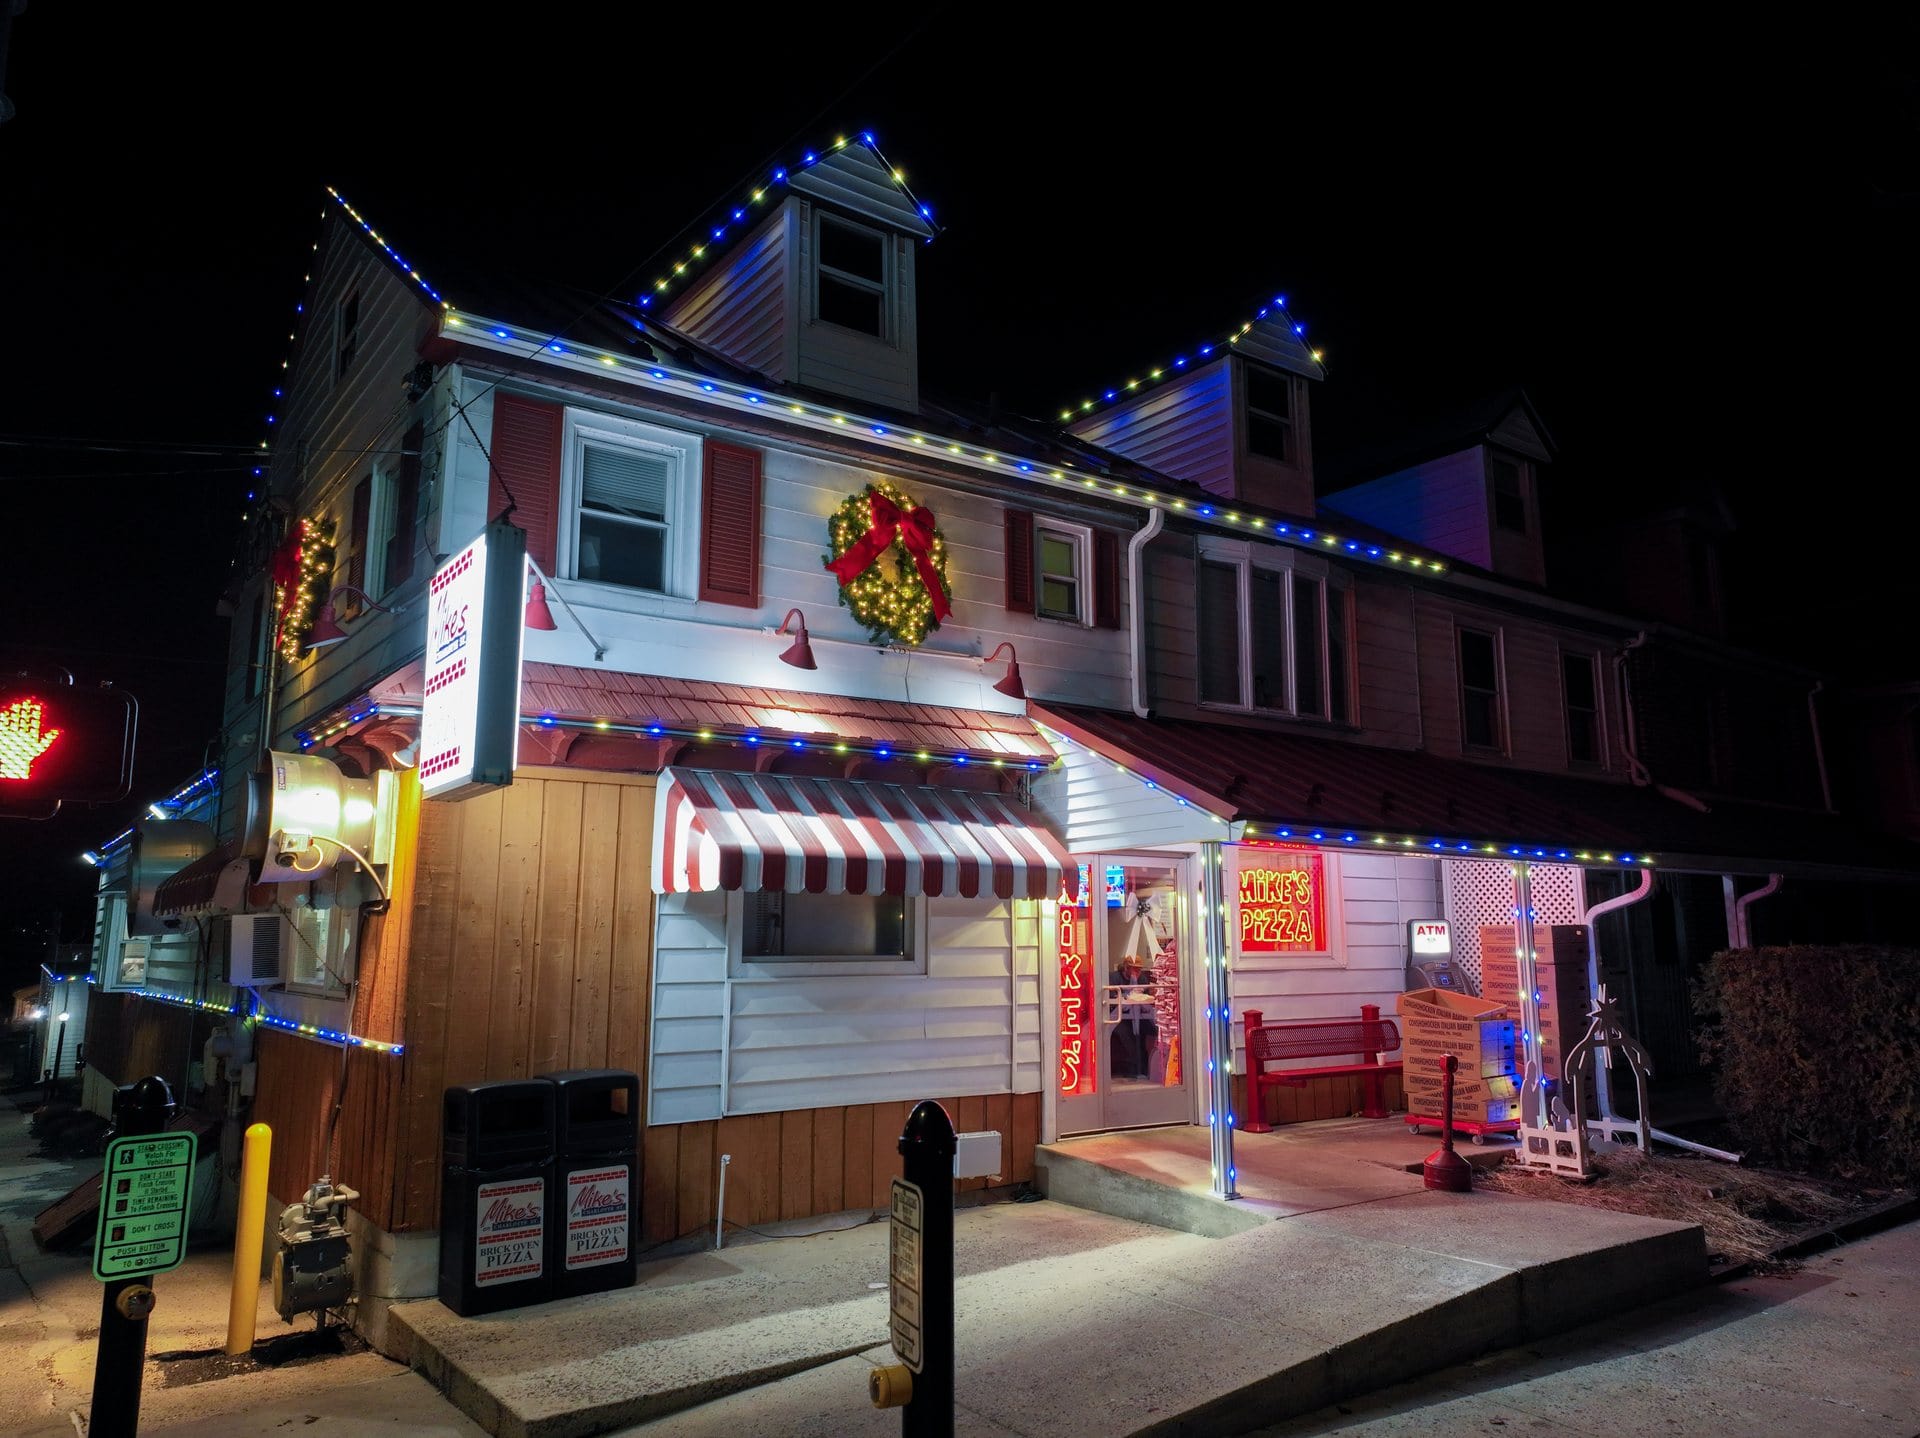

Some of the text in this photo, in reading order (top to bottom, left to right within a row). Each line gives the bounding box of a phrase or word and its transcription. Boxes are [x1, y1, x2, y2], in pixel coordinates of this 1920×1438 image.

[1416, 925, 1446, 936] ATM
[1457, 1022, 1473, 1031] BAKERY
[1458, 1042, 1474, 1051] BAKERY
[570, 1184, 627, 1214] Mike's
[480, 1197, 542, 1228] Mike's
[153, 1221, 175, 1231] CROSS
[570, 1226, 625, 1242] BRICK OVEN
[116, 1242, 166, 1256] PUSH BUTTON
[480, 1240, 540, 1257] BRICK OVEN
[576, 1236, 621, 1251] PIZZA
[123, 1260, 132, 1268] TO
[486, 1251, 534, 1268] PIZZA
